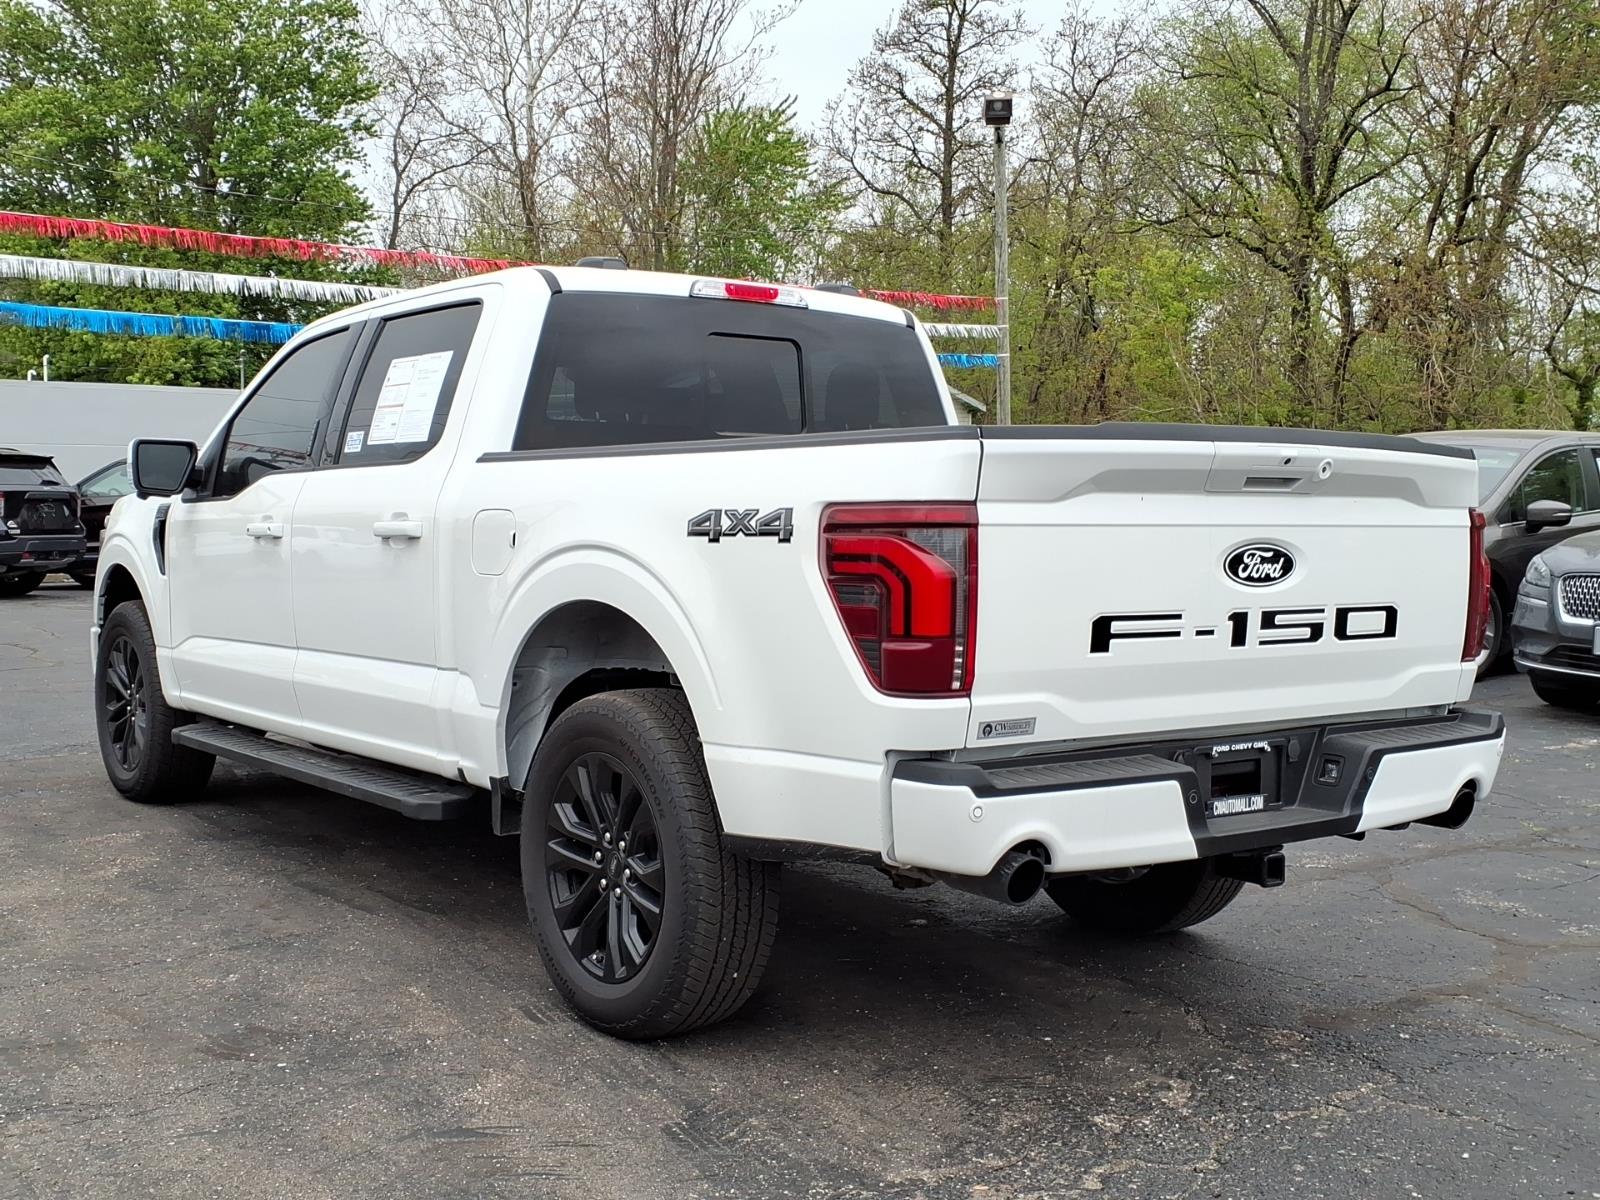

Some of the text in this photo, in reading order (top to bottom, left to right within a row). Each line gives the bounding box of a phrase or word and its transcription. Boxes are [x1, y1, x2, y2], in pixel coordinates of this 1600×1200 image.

[1237, 550, 1285, 579] Ford
[1089, 604, 1399, 654] F-150
[1213, 741, 1268, 753] FORD CHEVY GMC
[1213, 795, 1264, 815] CWAUTOMALL.COM
